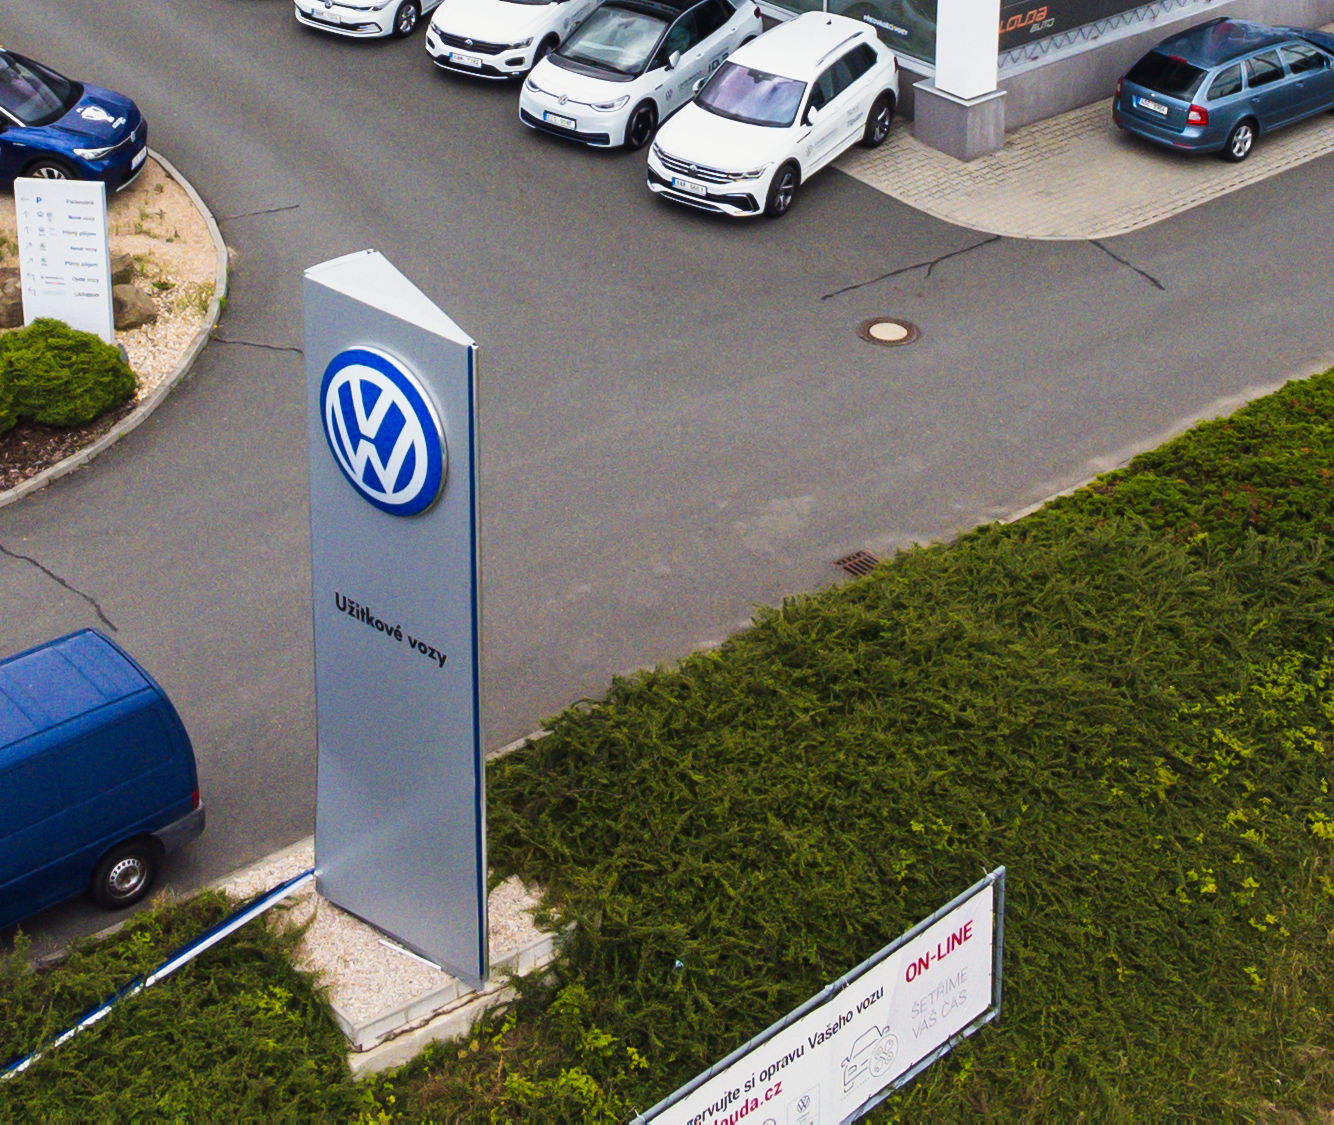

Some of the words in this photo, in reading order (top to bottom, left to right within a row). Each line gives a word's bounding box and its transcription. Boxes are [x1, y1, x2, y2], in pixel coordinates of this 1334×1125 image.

[335, 591, 403, 642] Užitkové
[407, 635, 447, 668] vozy
[906, 919, 974, 983] ON-LINE
[941, 988, 967, 1019] ČAS
[744, 1072, 756, 1093] si
[759, 1045, 805, 1083] opravu
[808, 1011, 854, 1050] Vašeho
[856, 986, 885, 1016] vozu
